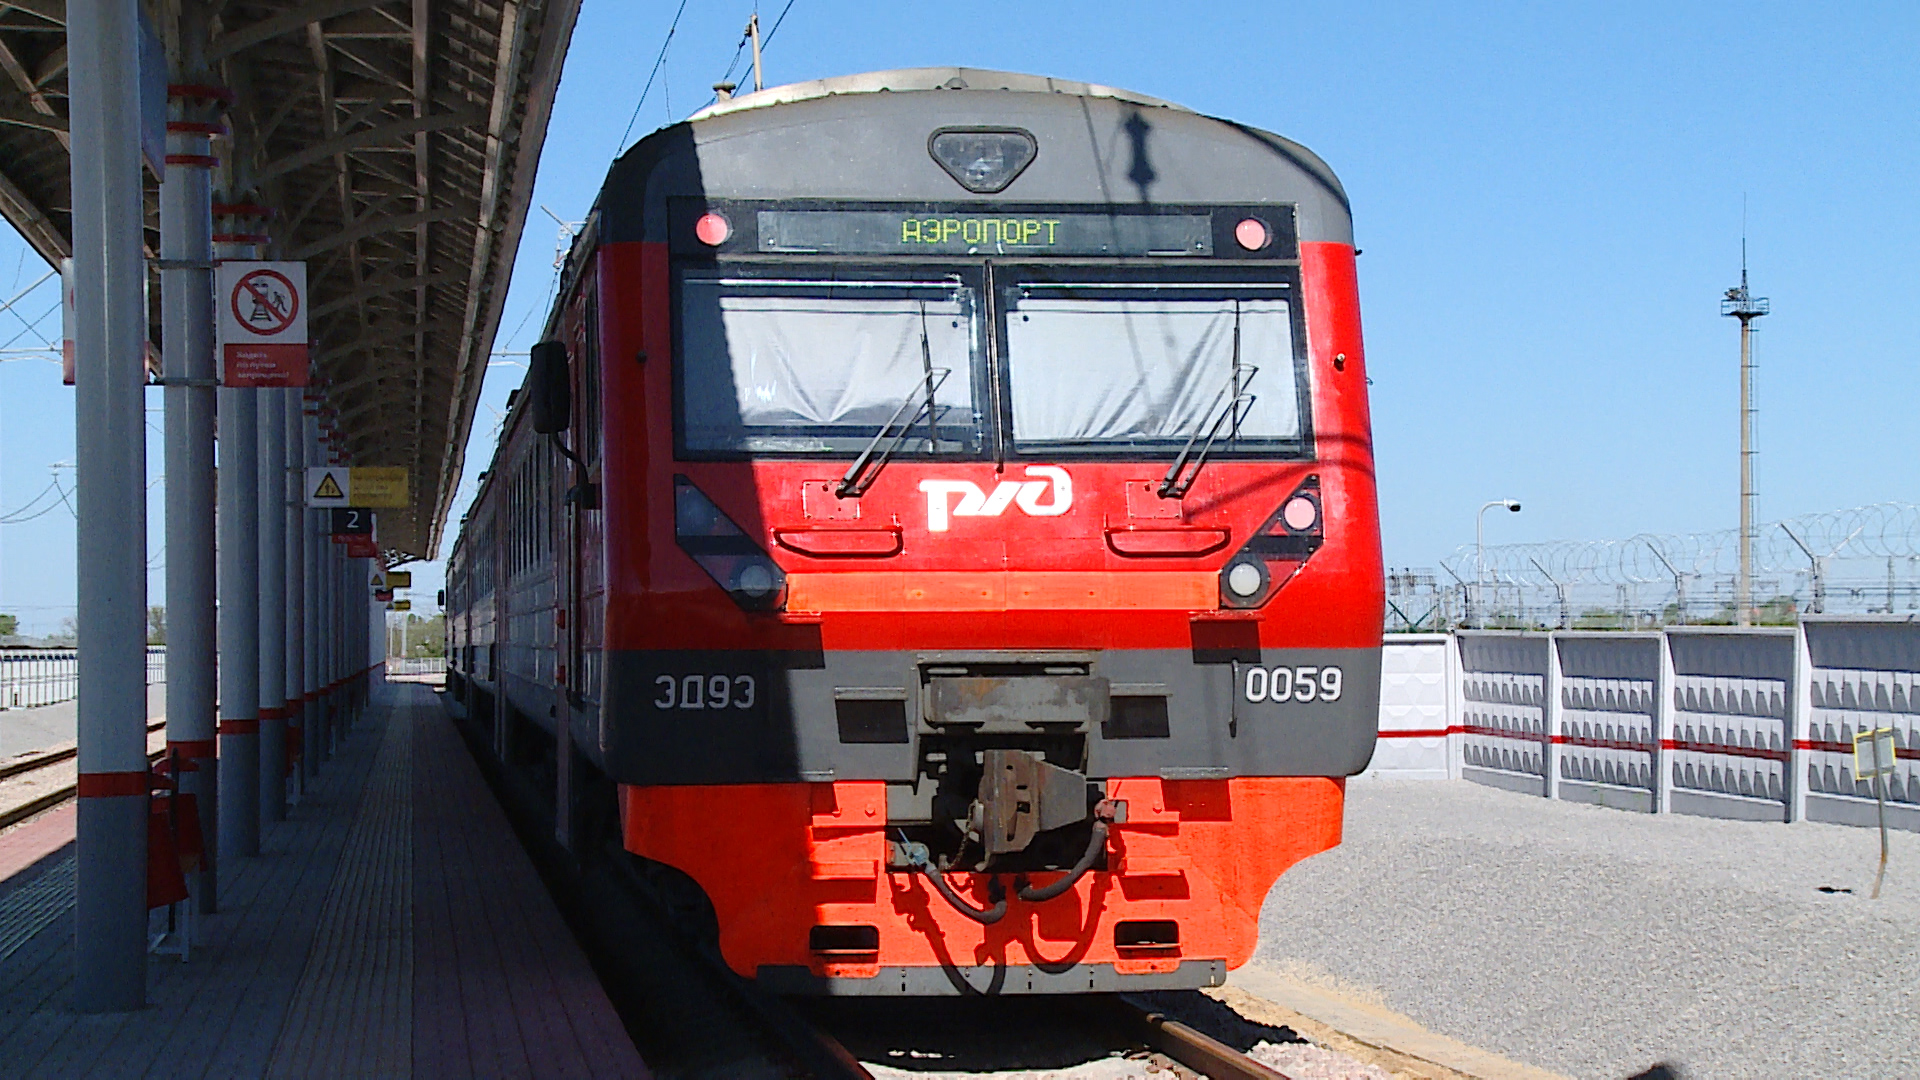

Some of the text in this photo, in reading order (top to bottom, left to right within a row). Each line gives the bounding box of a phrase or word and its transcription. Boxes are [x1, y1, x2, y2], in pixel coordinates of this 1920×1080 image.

[902, 219, 1061, 244] АЭРОПОРТ
[346, 510, 359, 528] 2
[1245, 666, 1343, 703] 0059
